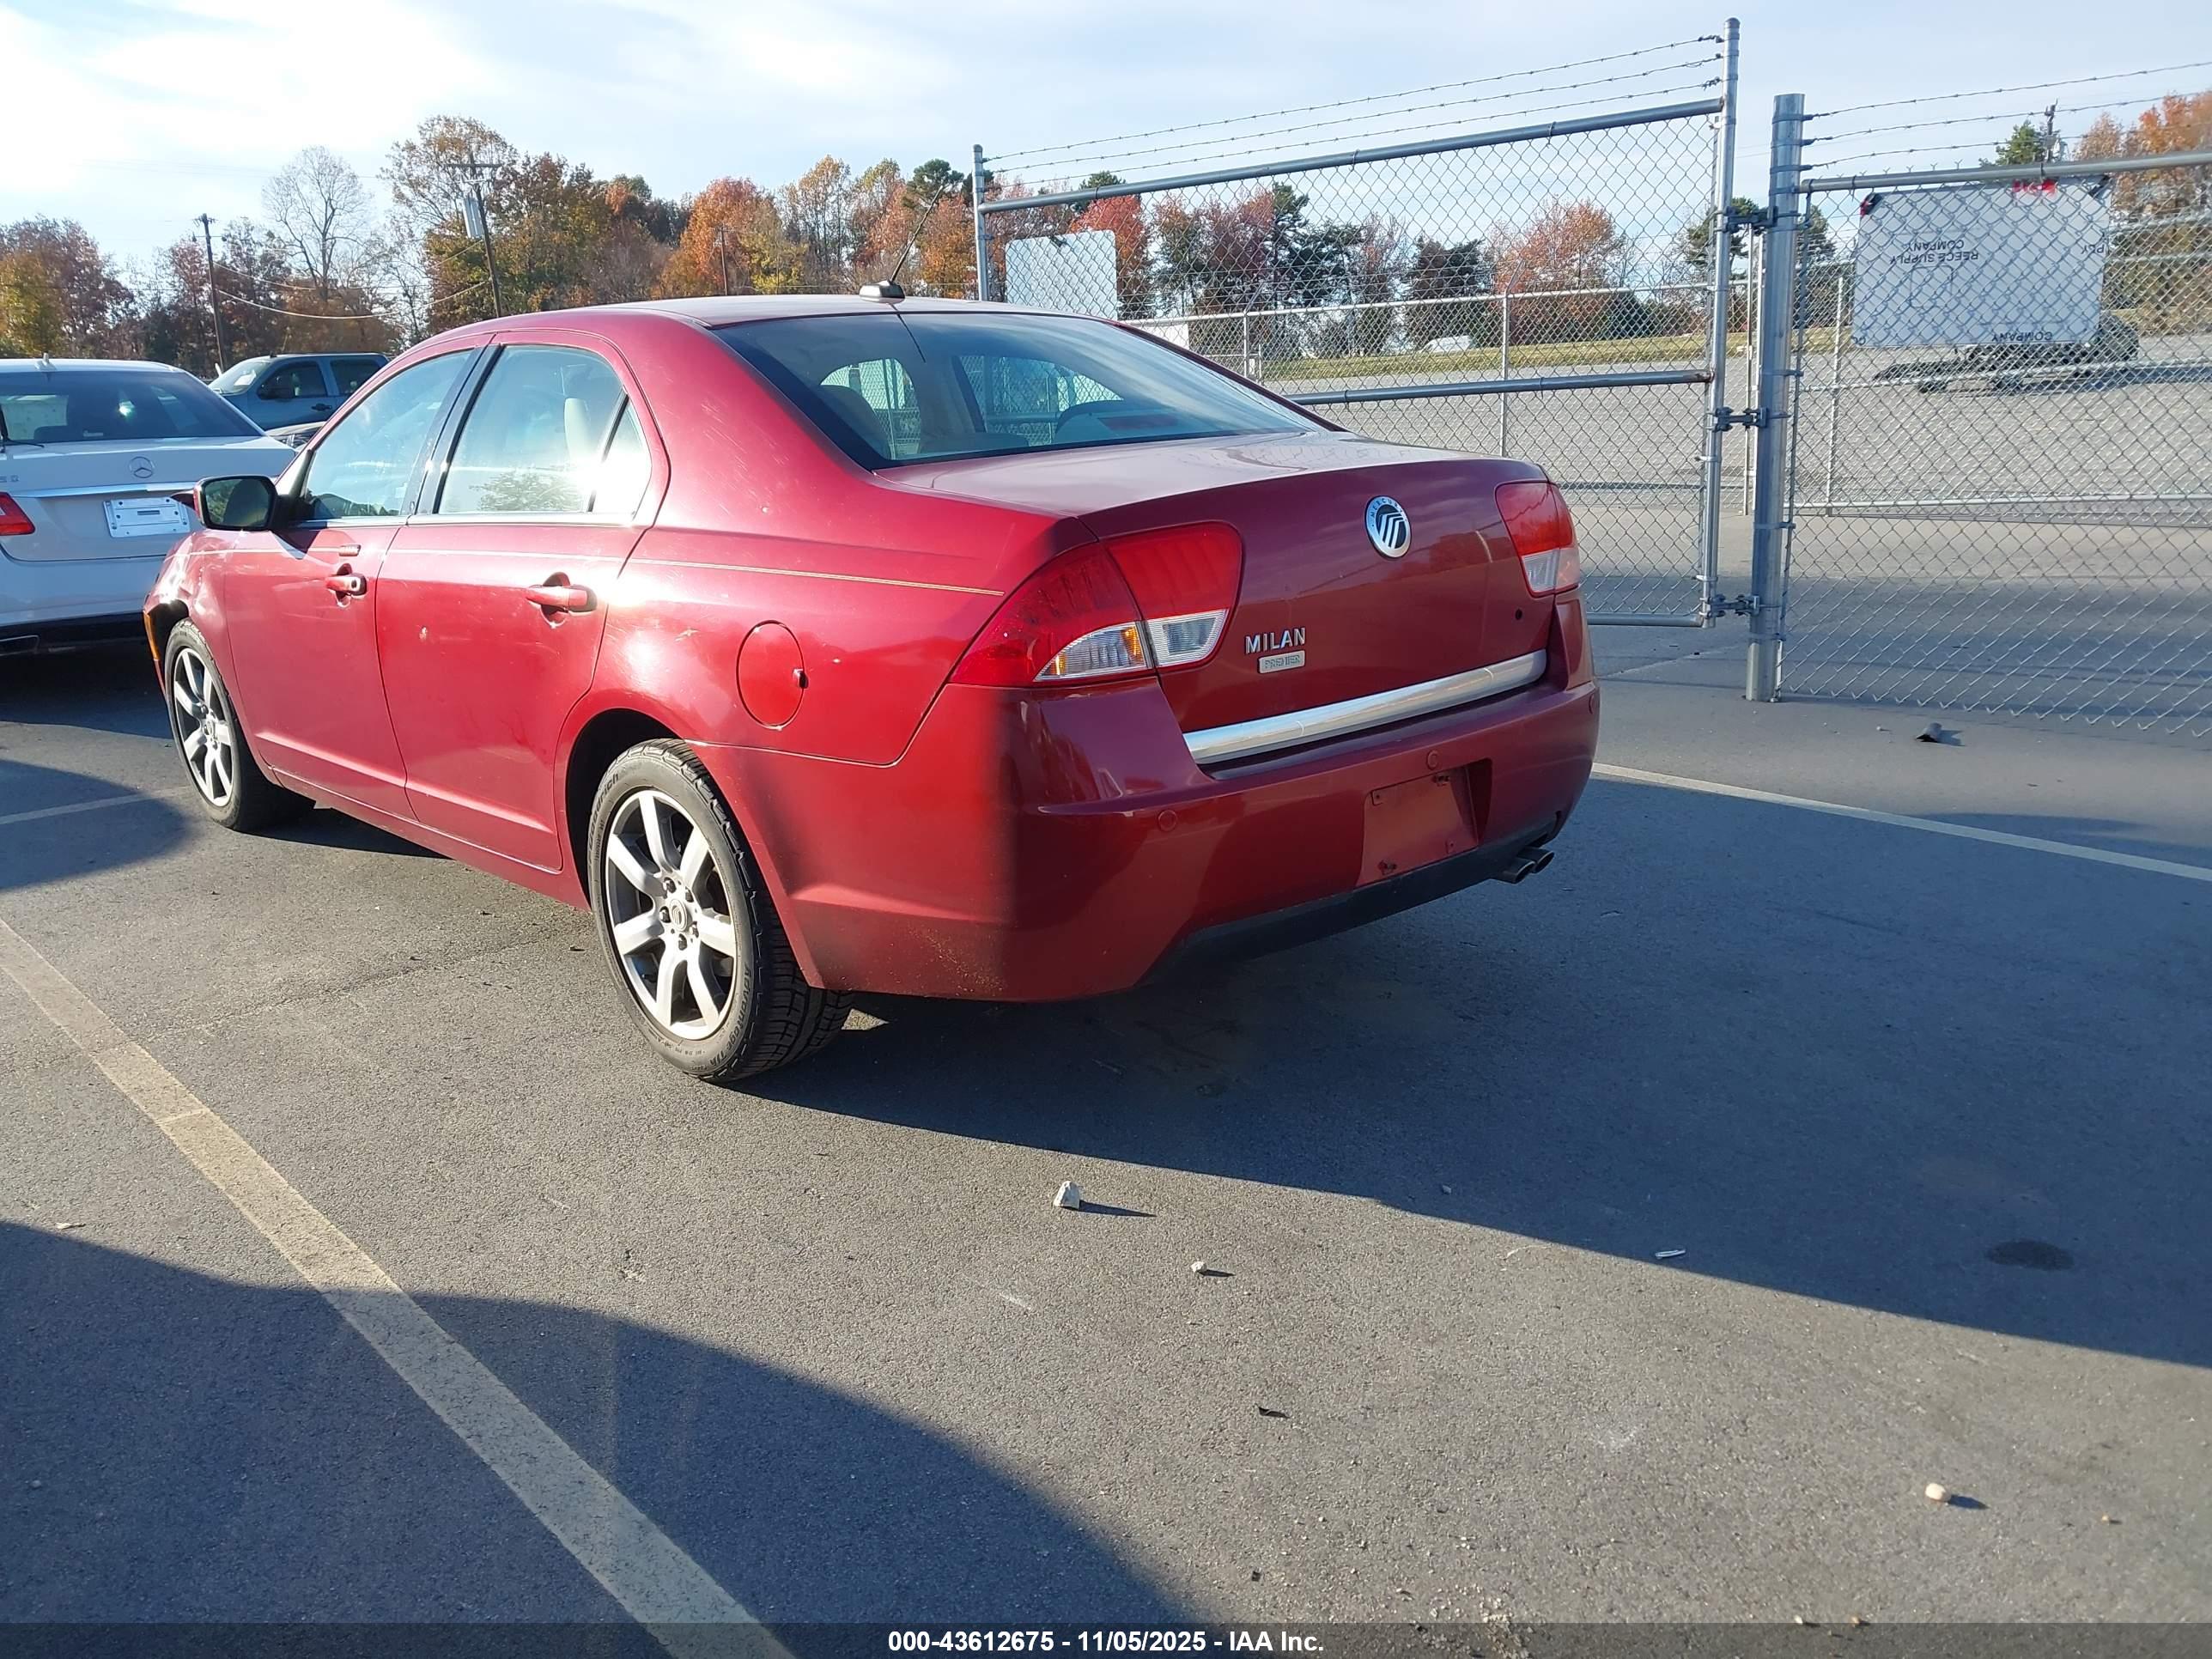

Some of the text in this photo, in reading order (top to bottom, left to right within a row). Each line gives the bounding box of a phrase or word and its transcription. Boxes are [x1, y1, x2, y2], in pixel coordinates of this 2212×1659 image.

[1907, 240, 1965, 252] COMPANY
[1889, 251, 1978, 264] REECE SUPPLY
[1245, 628, 1305, 654] MILAN
